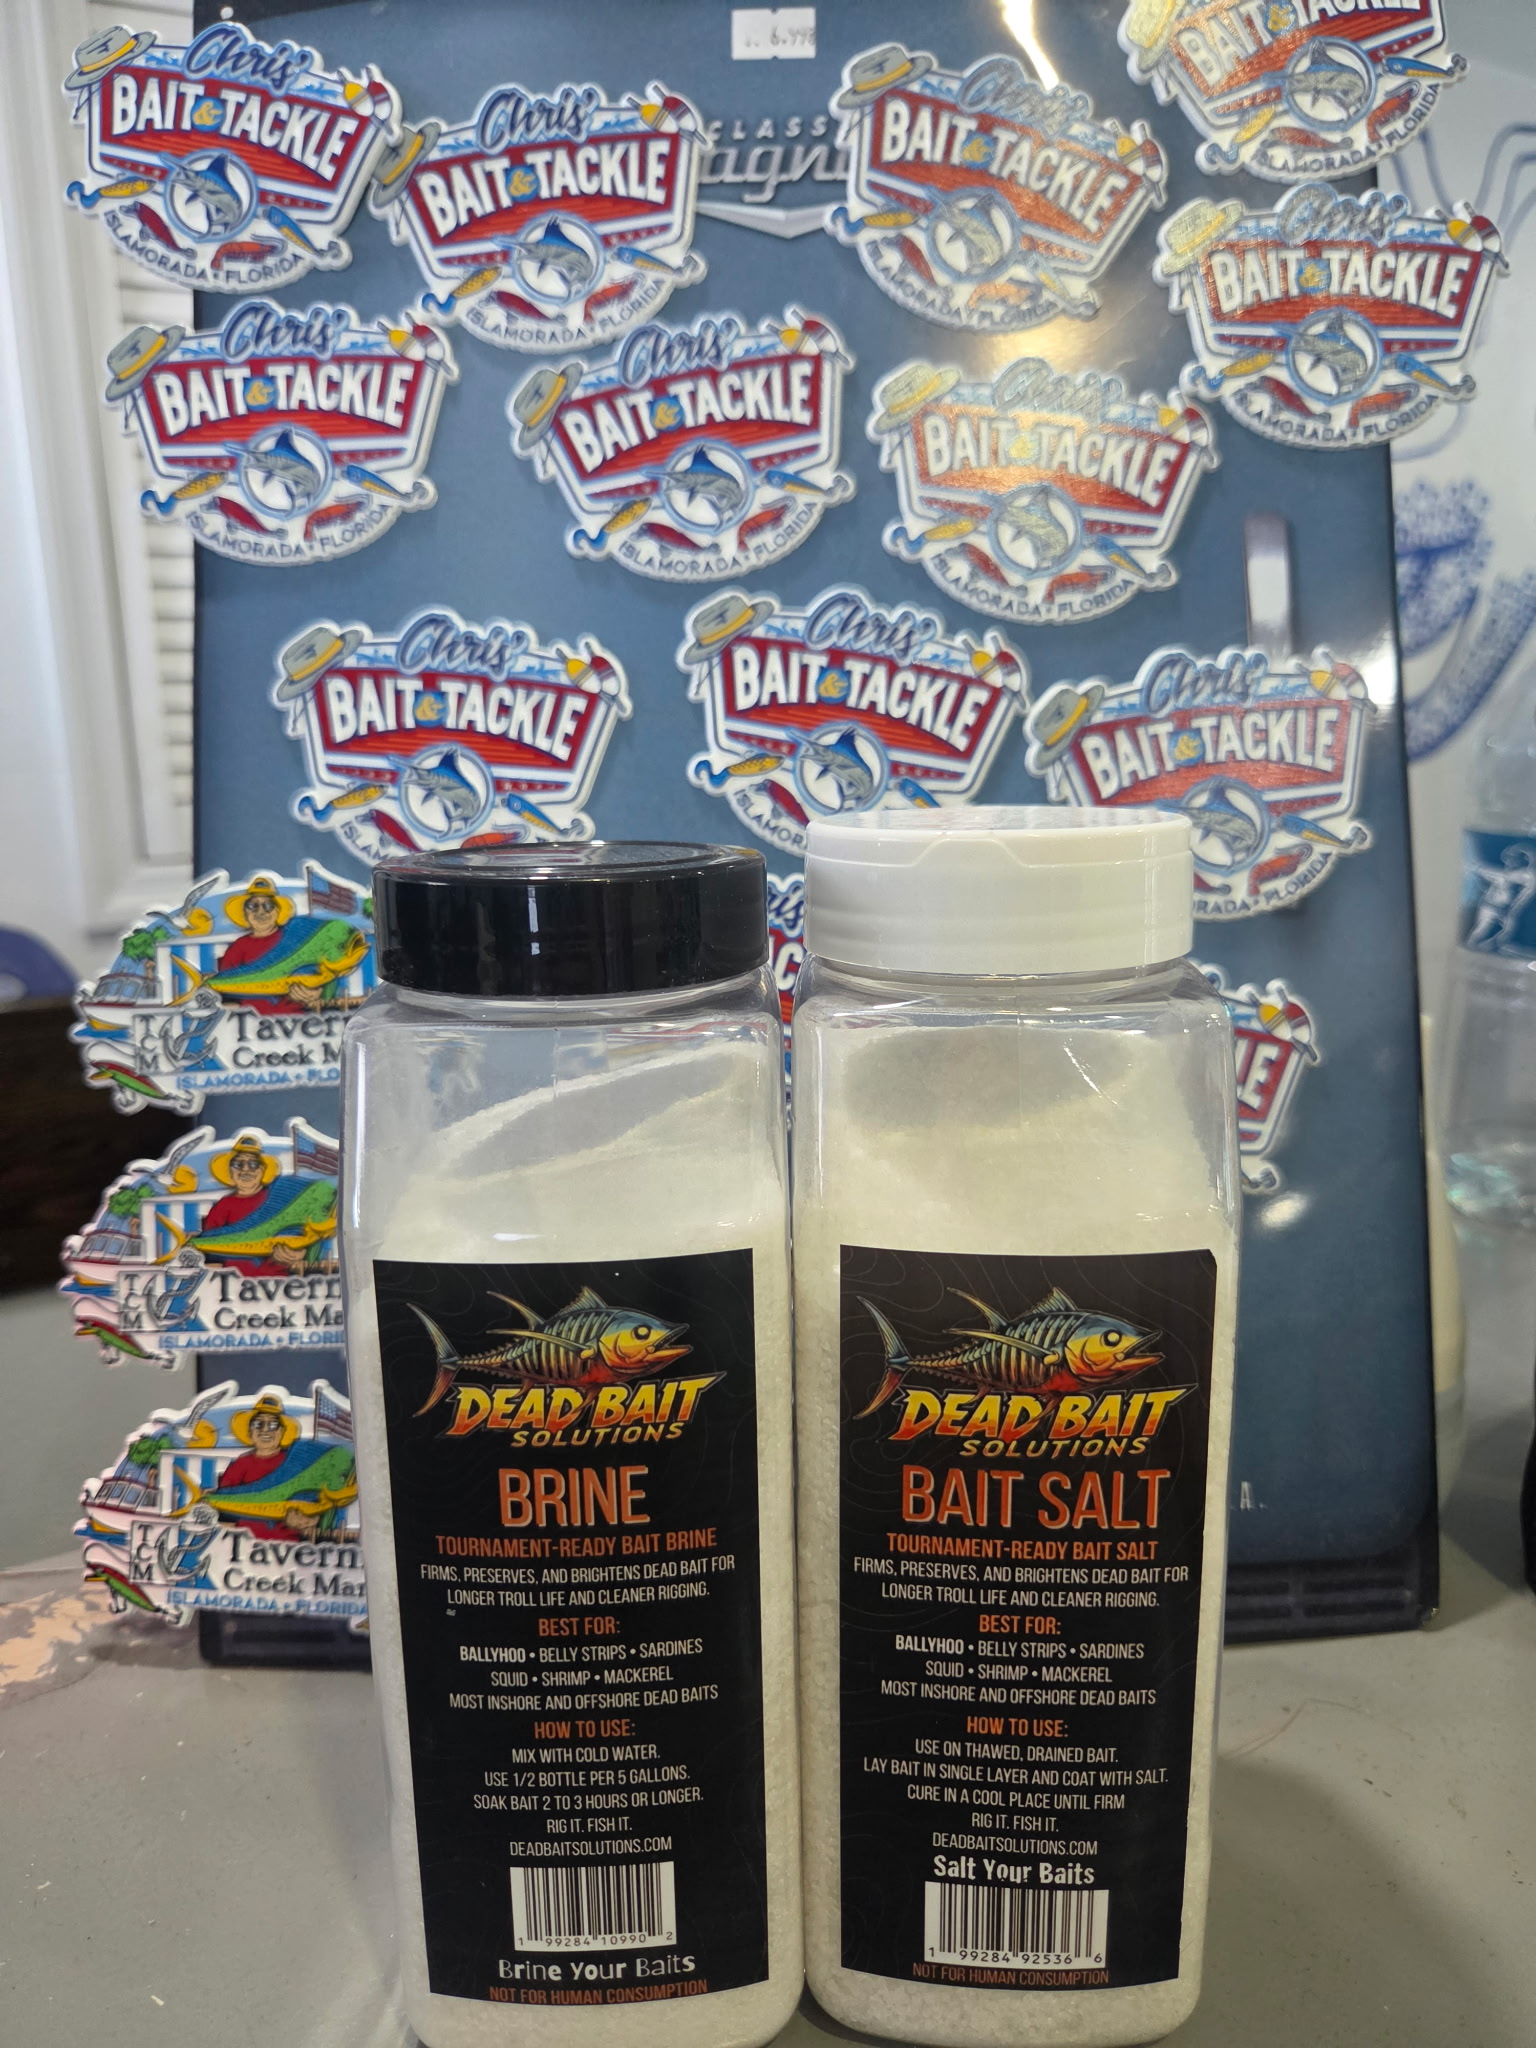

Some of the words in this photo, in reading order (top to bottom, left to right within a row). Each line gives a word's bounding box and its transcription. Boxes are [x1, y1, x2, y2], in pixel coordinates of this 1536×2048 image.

[187, 28, 309, 88] Chris'
[1177, 3, 1273, 88] BAIT
[112, 74, 205, 136] BAIT
[194, 101, 222, 127] &
[219, 89, 359, 182] TACKLE
[479, 88, 597, 148] Chris'
[880, 97, 978, 165] BAIT
[988, 129, 1129, 233] TACKLE
[416, 158, 513, 238] BAIT
[509, 170, 537, 196] &
[526, 138, 670, 205] TACKLE
[104, 211, 209, 280] ISLAMORADA
[225, 253, 304, 284] FLORIDA
[1211, 250, 1304, 313] BAIT
[1322, 250, 1470, 319] TACKLE
[467, 307, 586, 345] ISLAMORADA
[601, 278, 666, 334] FLORIDA
[225, 303, 348, 359] Chris'
[619, 318, 737, 386] Chris'
[154, 366, 251, 437] BAIT
[246, 383, 274, 406] &
[269, 362, 414, 429] TACKLE
[560, 391, 656, 473] BAIT
[654, 401, 681, 428] &
[669, 362, 813, 428] TACKLE
[924, 415, 1015, 476] BAIT
[1037, 424, 1181, 508] TACKLE
[619, 540, 742, 575] ISLAMORADA
[753, 502, 817, 562] FLORIDA
[806, 593, 936, 661] Chris'
[399, 614, 525, 674] Chris'
[731, 647, 829, 712] BAIT
[818, 671, 848, 699] &
[845, 659, 991, 752] TACKLE
[326, 676, 424, 744] BAIT
[416, 697, 444, 721] &
[441, 682, 589, 762] TACKLE
[1082, 722, 1174, 800] BAIT
[1174, 735, 1199, 761] &
[1191, 707, 1339, 773] TACKLE
[232, 1046, 312, 1069] Creek
[177, 1070, 288, 1089] ISLAMORADA
[214, 1305, 297, 1329] Creek
[159, 1331, 272, 1349] ISLAMORADA
[445, 1385, 586, 1437] DEAD
[592, 1375, 722, 1428] BAIT
[889, 1389, 1043, 1442] DEAD
[1050, 1388, 1188, 1439] BAIT
[511, 1421, 685, 1448] SOLUTIONS
[960, 1437, 1150, 1459] SOLUTIONS
[499, 1465, 650, 1527] BRINE
[902, 1464, 1024, 1527] BAIT
[1038, 1468, 1171, 1530] SALT
[436, 1536, 616, 1557] TOURNAMENT-READY
[622, 1534, 660, 1554] BAIT
[667, 1528, 716, 1550] BRINE
[887, 1533, 1068, 1559] TOURNAMENT-READY
[1073, 1542, 1112, 1560] BAIT
[1117, 1541, 1158, 1560] SALT
[223, 1569, 303, 1594] Creek
[421, 1564, 460, 1582] FIRMS,
[464, 1567, 538, 1584] PRESERVES,
[542, 1569, 567, 1583] AND
[571, 1565, 640, 1583] BRIGHTENS
[644, 1562, 677, 1579] DEAD
[681, 1558, 708, 1575] BAIT
[712, 1555, 734, 1572] FOR
[167, 1590, 278, 1611] ISLAMORADA
[882, 1583, 932, 1600] LONGER
[936, 1587, 976, 1603] TROLL
[981, 1589, 1007, 1605] LIFE
[1011, 1591, 1038, 1606] AND
[1042, 1592, 1101, 1607] CLEANER
[1105, 1592, 1160, 1607] RIGGING.
[539, 1618, 579, 1636] BEST
[585, 1617, 620, 1635] FOR:
[460, 1646, 525, 1662] BALLYHOO
[540, 1647, 577, 1662] BELLY
[582, 1645, 626, 1661] STRIPS
[640, 1638, 702, 1658] SARDINES
[491, 1672, 528, 1686] SQUID
[542, 1671, 590, 1686] SHRIMP
[604, 1666, 673, 1684] MACKEREL
[882, 1680, 917, 1696] MOST
[921, 1683, 975, 1701] INSHORE
[980, 1687, 1006, 1703] AND
[1010, 1689, 1076, 1705] OFFSHORE
[1080, 1690, 1115, 1705] DEAD
[1119, 1690, 1156, 1705] BAITS
[535, 1722, 570, 1738] HOW
[576, 1721, 595, 1737] TO
[601, 1719, 635, 1737] USE:
[916, 1739, 939, 1755] USE
[944, 1741, 961, 1756] ON
[965, 1743, 1023, 1761] THAWED,
[1027, 1746, 1083, 1762] DRAINED
[1087, 1748, 1118, 1762] BAIT.
[485, 1772, 508, 1786] USE
[514, 1773, 535, 1787] 1/2
[539, 1772, 586, 1786] BOTTLE
[590, 1771, 614, 1785] PER
[618, 1770, 626, 1784] 5
[630, 1765, 690, 1784] GALLONS.
[864, 1757, 887, 1773] LAY
[891, 1760, 920, 1776] BAIT
[924, 1763, 935, 1777] IN
[940, 1764, 983, 1781] SINGLE
[987, 1767, 1028, 1784] LAYER
[1032, 1770, 1058, 1785] AND
[1063, 1771, 1096, 1786] COAT
[1100, 1771, 1132, 1786] WITH
[1136, 1768, 1168, 1784] SALT.
[474, 1795, 507, 1809] SOAK
[511, 1796, 538, 1810] BAIT
[543, 1796, 550, 1810] 2
[554, 1796, 570, 1810] TO
[574, 1795, 582, 1809] 3
[586, 1793, 628, 1809] HOURS
[632, 1792, 648, 1807] OR
[652, 1787, 703, 1805] LONGER.
[908, 1784, 940, 1801] CURE
[945, 1788, 956, 1802] IN
[960, 1789, 969, 1803] A
[973, 1790, 1005, 1806] COOL
[1010, 1792, 1050, 1808] PLACE
[1054, 1794, 1090, 1809] UNTIL
[1094, 1794, 1124, 1809] FIRM
[510, 1836, 671, 1856] DEADBAITSOLUTIONS.COM
[933, 1832, 1097, 1855] DEADBAITSOLUTIONS.COM
[934, 1855, 976, 1880] Salt
[983, 1859, 1032, 1884] Your
[1040, 1863, 1094, 1885] Baits
[518, 1937, 524, 1947] 1
[545, 1937, 591, 1948] 99284
[601, 1934, 647, 1946] 10990
[666, 1931, 673, 1941] 2
[499, 1959, 562, 1981] Brine
[570, 1962, 627, 1981] Your
[636, 1954, 696, 1978] Baits
[928, 1948, 935, 1957] 1
[960, 1949, 1010, 1963] 99284
[1022, 1951, 1072, 1965] 92536
[1094, 1952, 1102, 1964] 6
[913, 1963, 936, 1979] NOT
[941, 1965, 965, 1982] FOR
[970, 1968, 1016, 1985] HUMAN
[1020, 1970, 1109, 1985] CONSUMPTION
